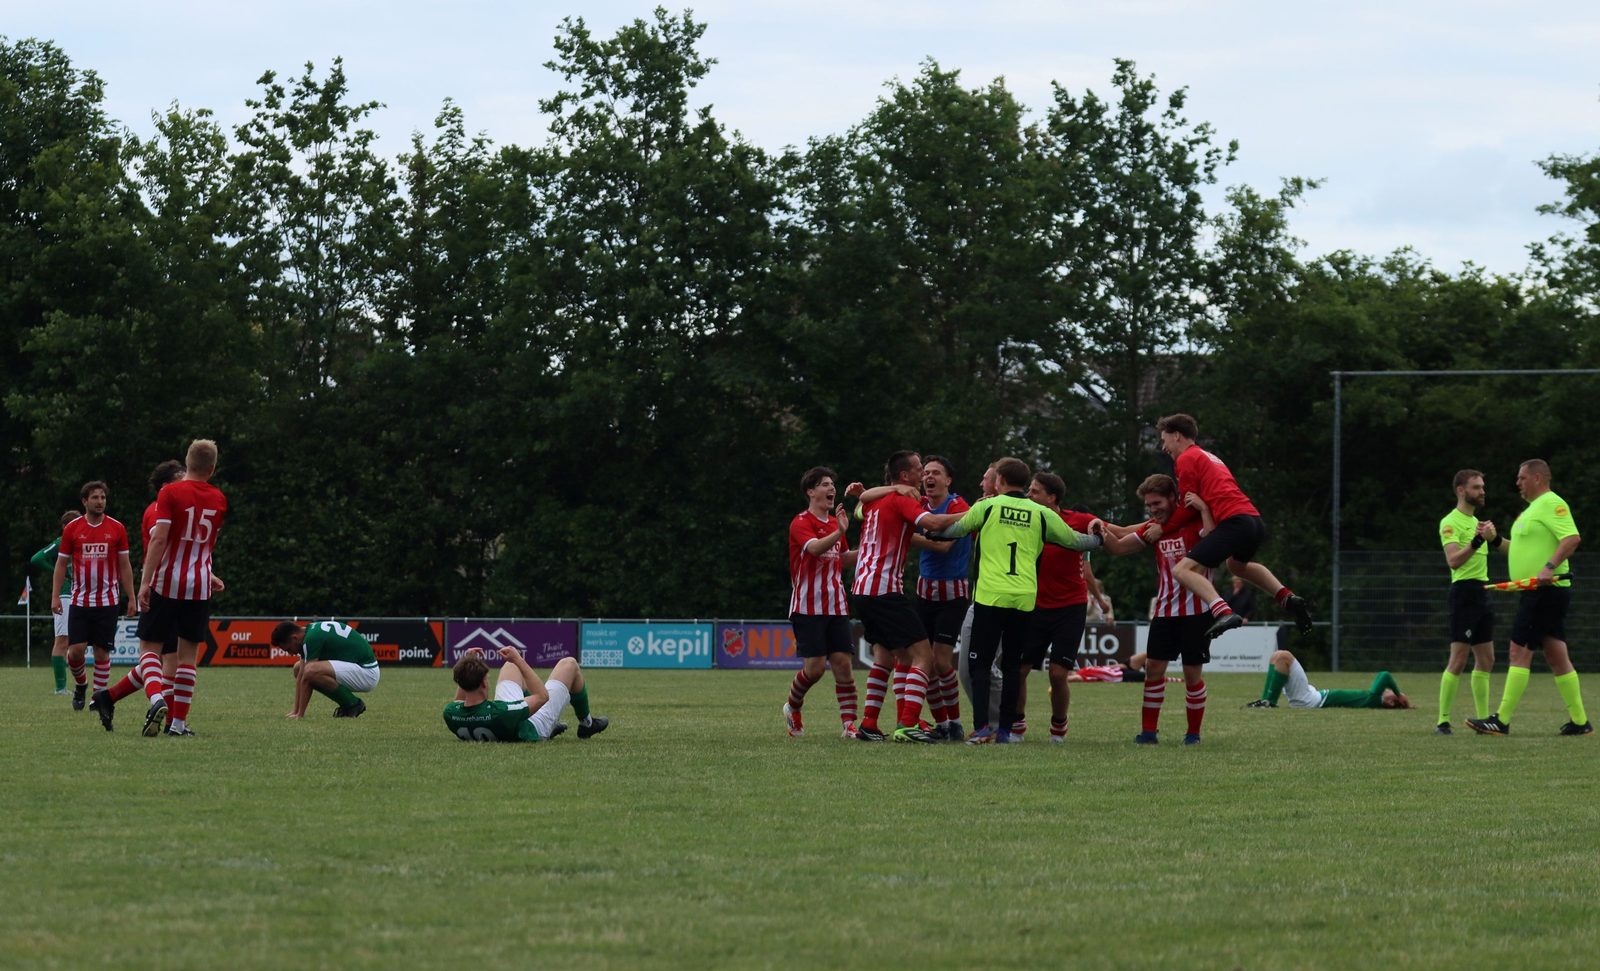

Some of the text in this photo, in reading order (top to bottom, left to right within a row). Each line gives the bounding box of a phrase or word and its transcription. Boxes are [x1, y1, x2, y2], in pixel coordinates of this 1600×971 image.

[181, 506, 217, 544] 15
[863, 509, 880, 545] 11
[1006, 541, 1019, 576] 1
[231, 631, 252, 641] our
[320, 620, 353, 639] 2
[230, 645, 268, 657] Future
[648, 630, 709, 663] kepil
